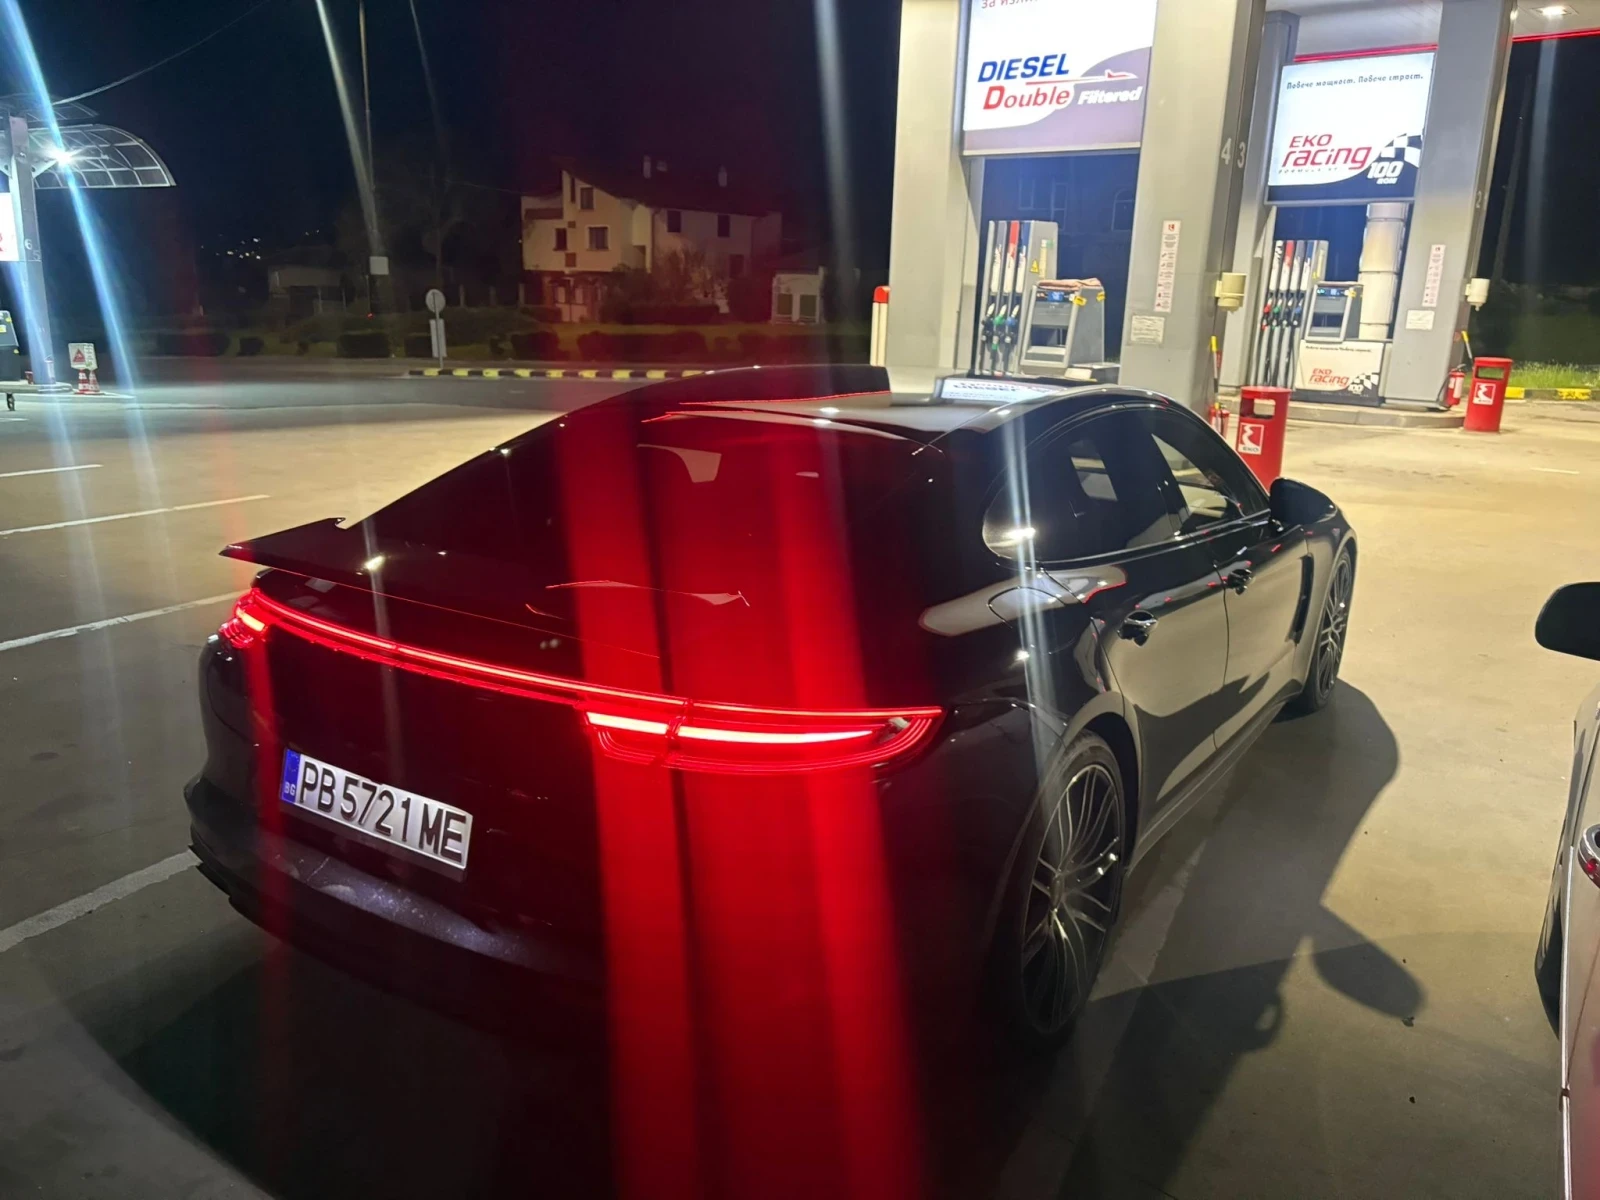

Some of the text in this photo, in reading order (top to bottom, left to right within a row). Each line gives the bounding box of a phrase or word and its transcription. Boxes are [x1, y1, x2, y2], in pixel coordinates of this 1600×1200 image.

[978, 53, 1069, 82] DIESEL
[1287, 74, 1423, 90] Повече мощност. Повече страст.
[983, 85, 1143, 110] Double Filtered
[1221, 137, 1231, 165] 4
[1289, 134, 1332, 148] EKO
[1237, 141, 1246, 168] 3
[1282, 147, 1372, 170] racing
[1367, 161, 1404, 179] 100
[24, 239, 32, 250] 6
[1309, 375, 1350, 387] racing
[284, 781, 296, 797] BG
[300, 761, 467, 863] PB 5721 ME
